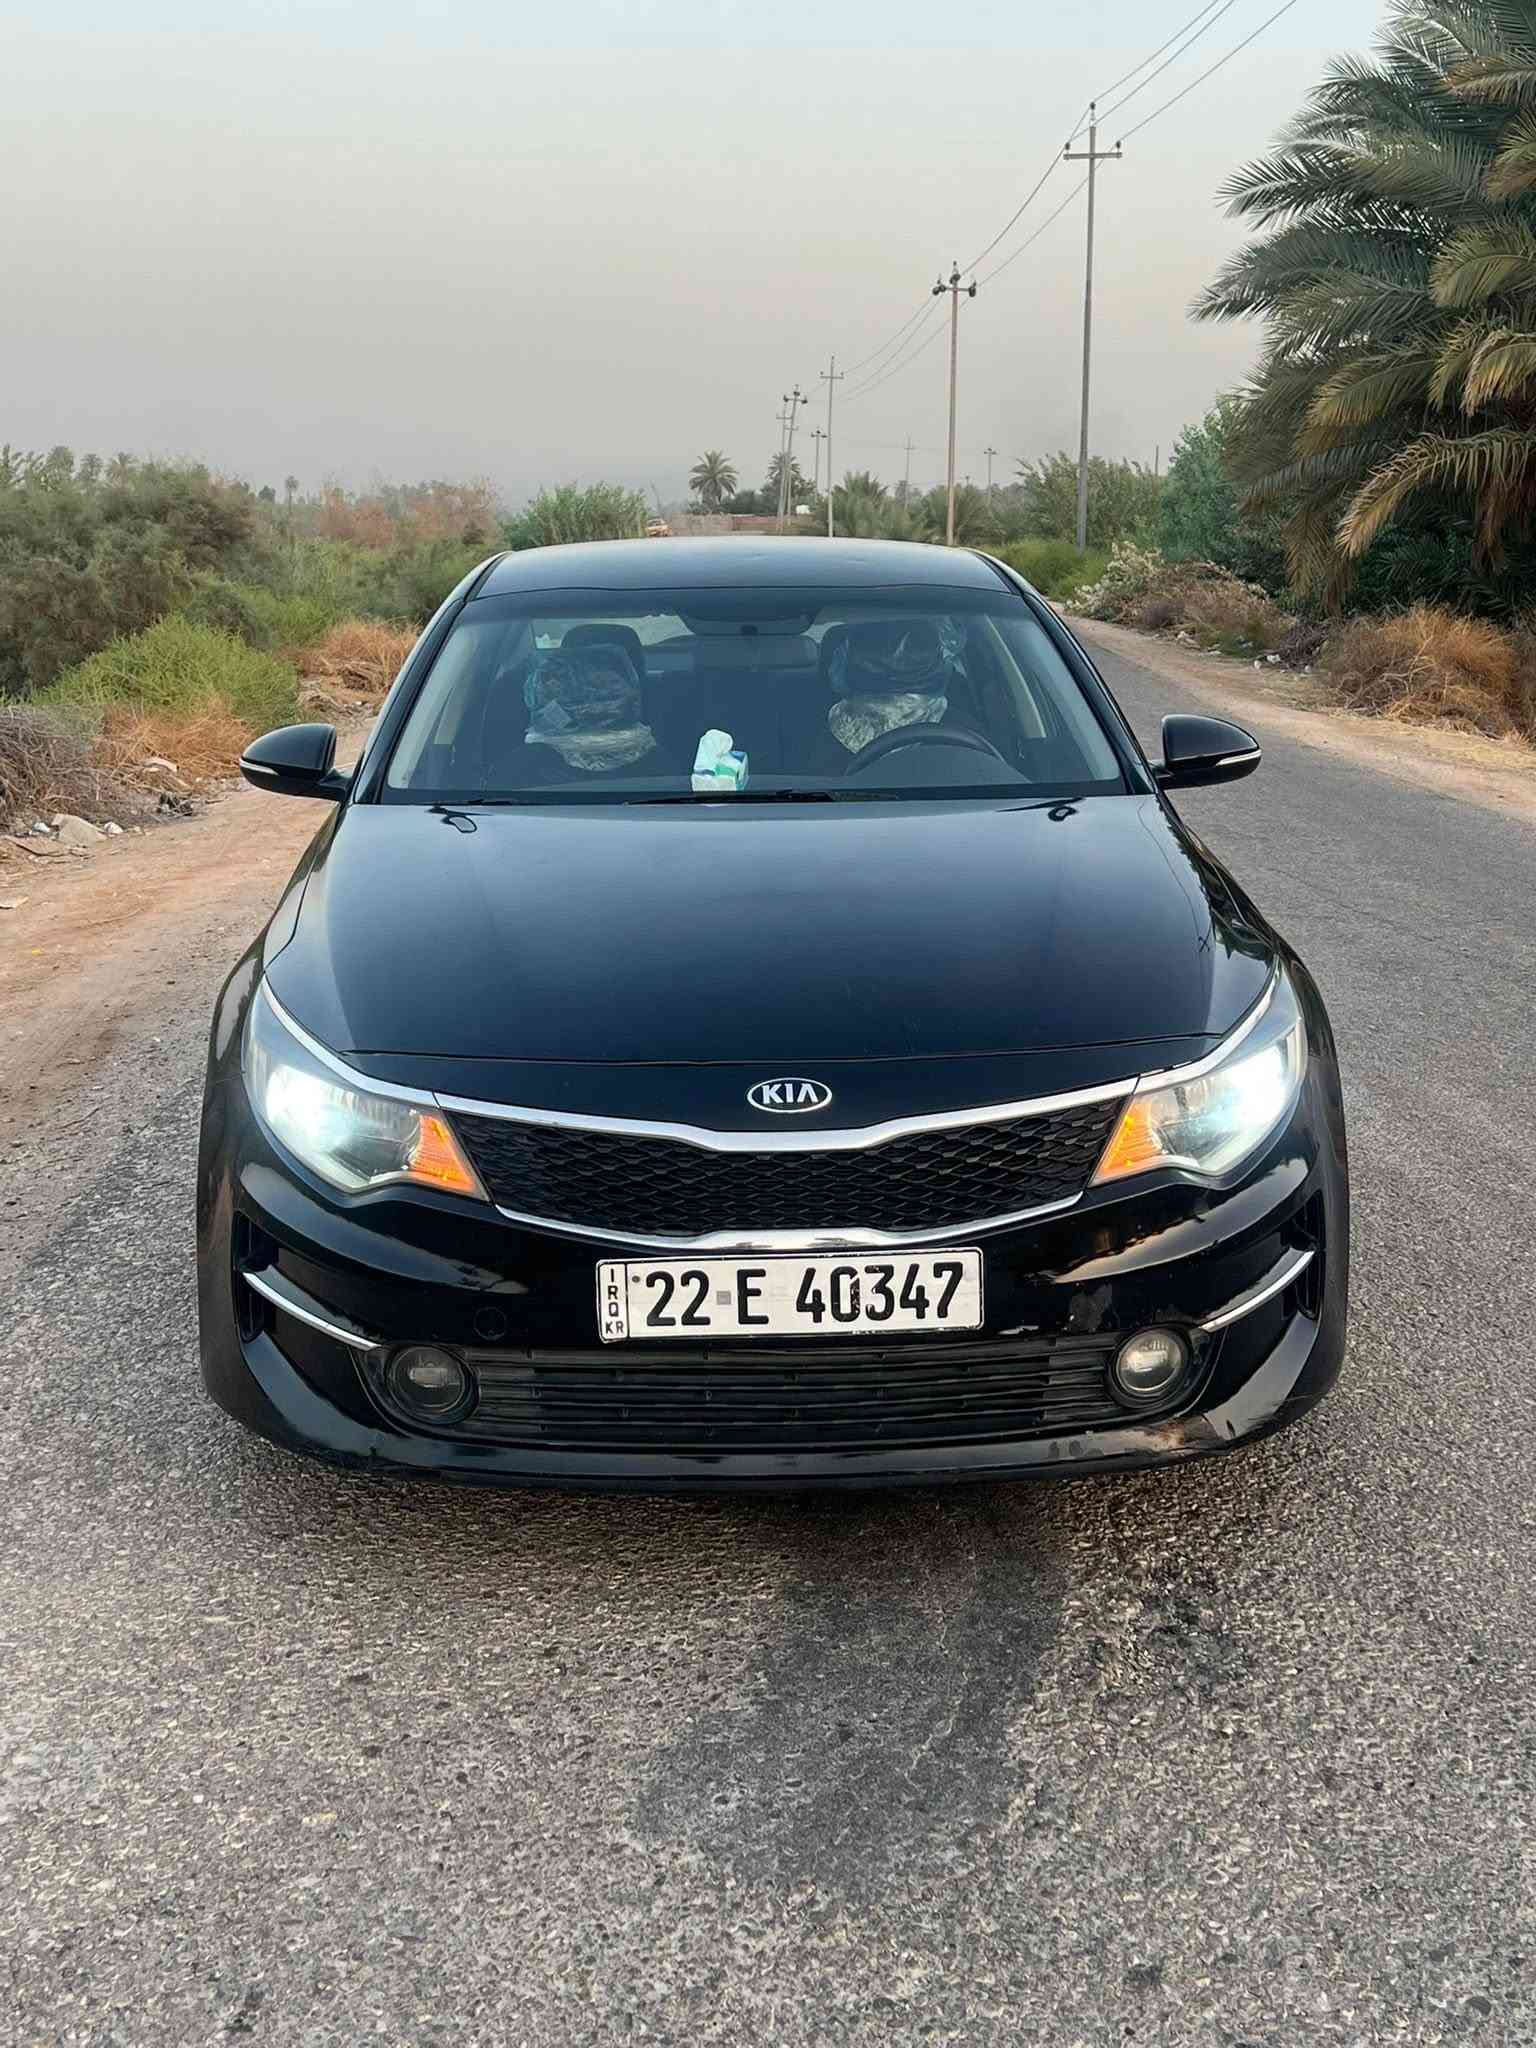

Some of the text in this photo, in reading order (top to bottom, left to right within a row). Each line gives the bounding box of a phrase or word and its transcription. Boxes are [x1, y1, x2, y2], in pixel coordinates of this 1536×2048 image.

[762, 1083, 818, 1104] KIA
[607, 1268, 619, 1317] IRQ
[646, 1262, 964, 1327] 22 E 40347
[605, 1321, 624, 1335] KR
